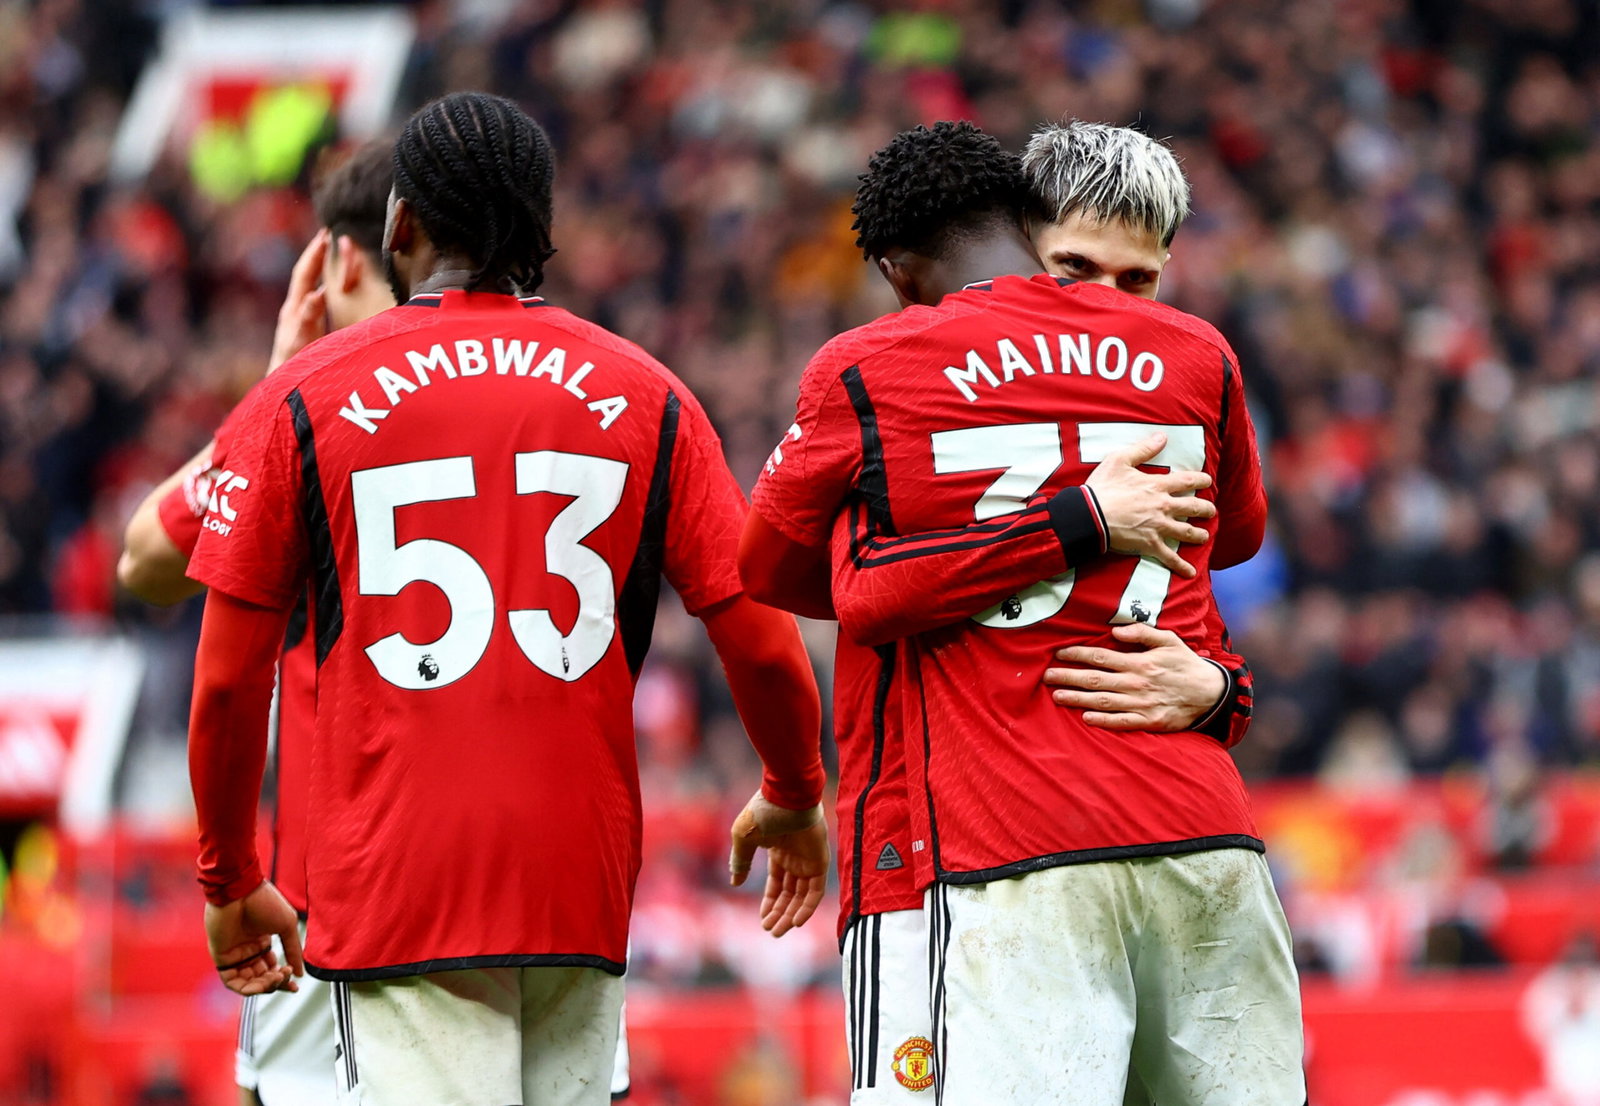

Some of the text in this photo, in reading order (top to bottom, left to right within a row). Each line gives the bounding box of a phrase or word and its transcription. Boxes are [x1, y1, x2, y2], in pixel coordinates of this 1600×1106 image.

[338, 338, 629, 435] KAMBWALA
[943, 333, 1165, 403] MAINOO
[351, 450, 630, 690] 53
[929, 421, 1206, 628] 37
[902, 1078, 932, 1088] UNITED
